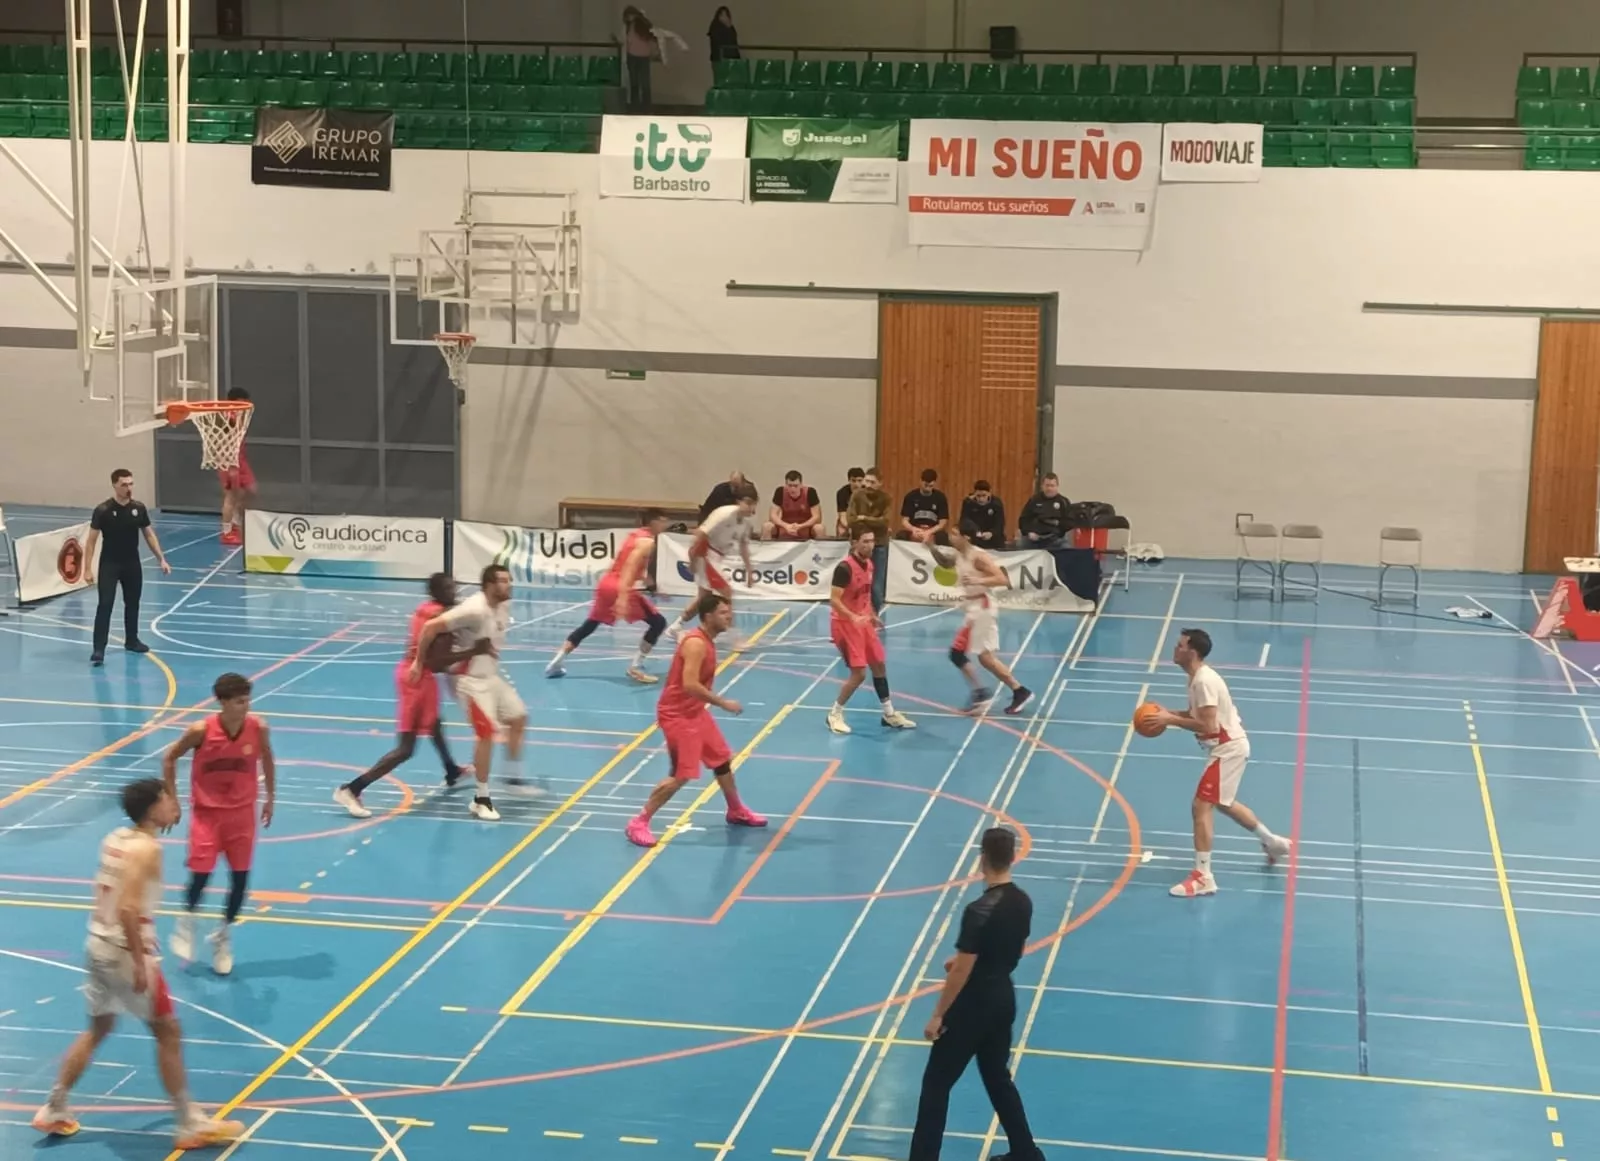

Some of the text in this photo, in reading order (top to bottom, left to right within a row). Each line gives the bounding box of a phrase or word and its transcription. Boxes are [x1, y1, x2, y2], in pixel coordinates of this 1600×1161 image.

[314, 127, 382, 145] GRUPO
[803, 132, 868, 145] Jusegal
[928, 128, 1143, 181] MI SUEÑO
[1170, 139, 1255, 164] MODOVIAJE
[633, 176, 711, 193] Barbastro
[923, 197, 1049, 213] Rotulamos tus sueños
[311, 524, 428, 544] audiocinca
[539, 532, 615, 559] Vidal
